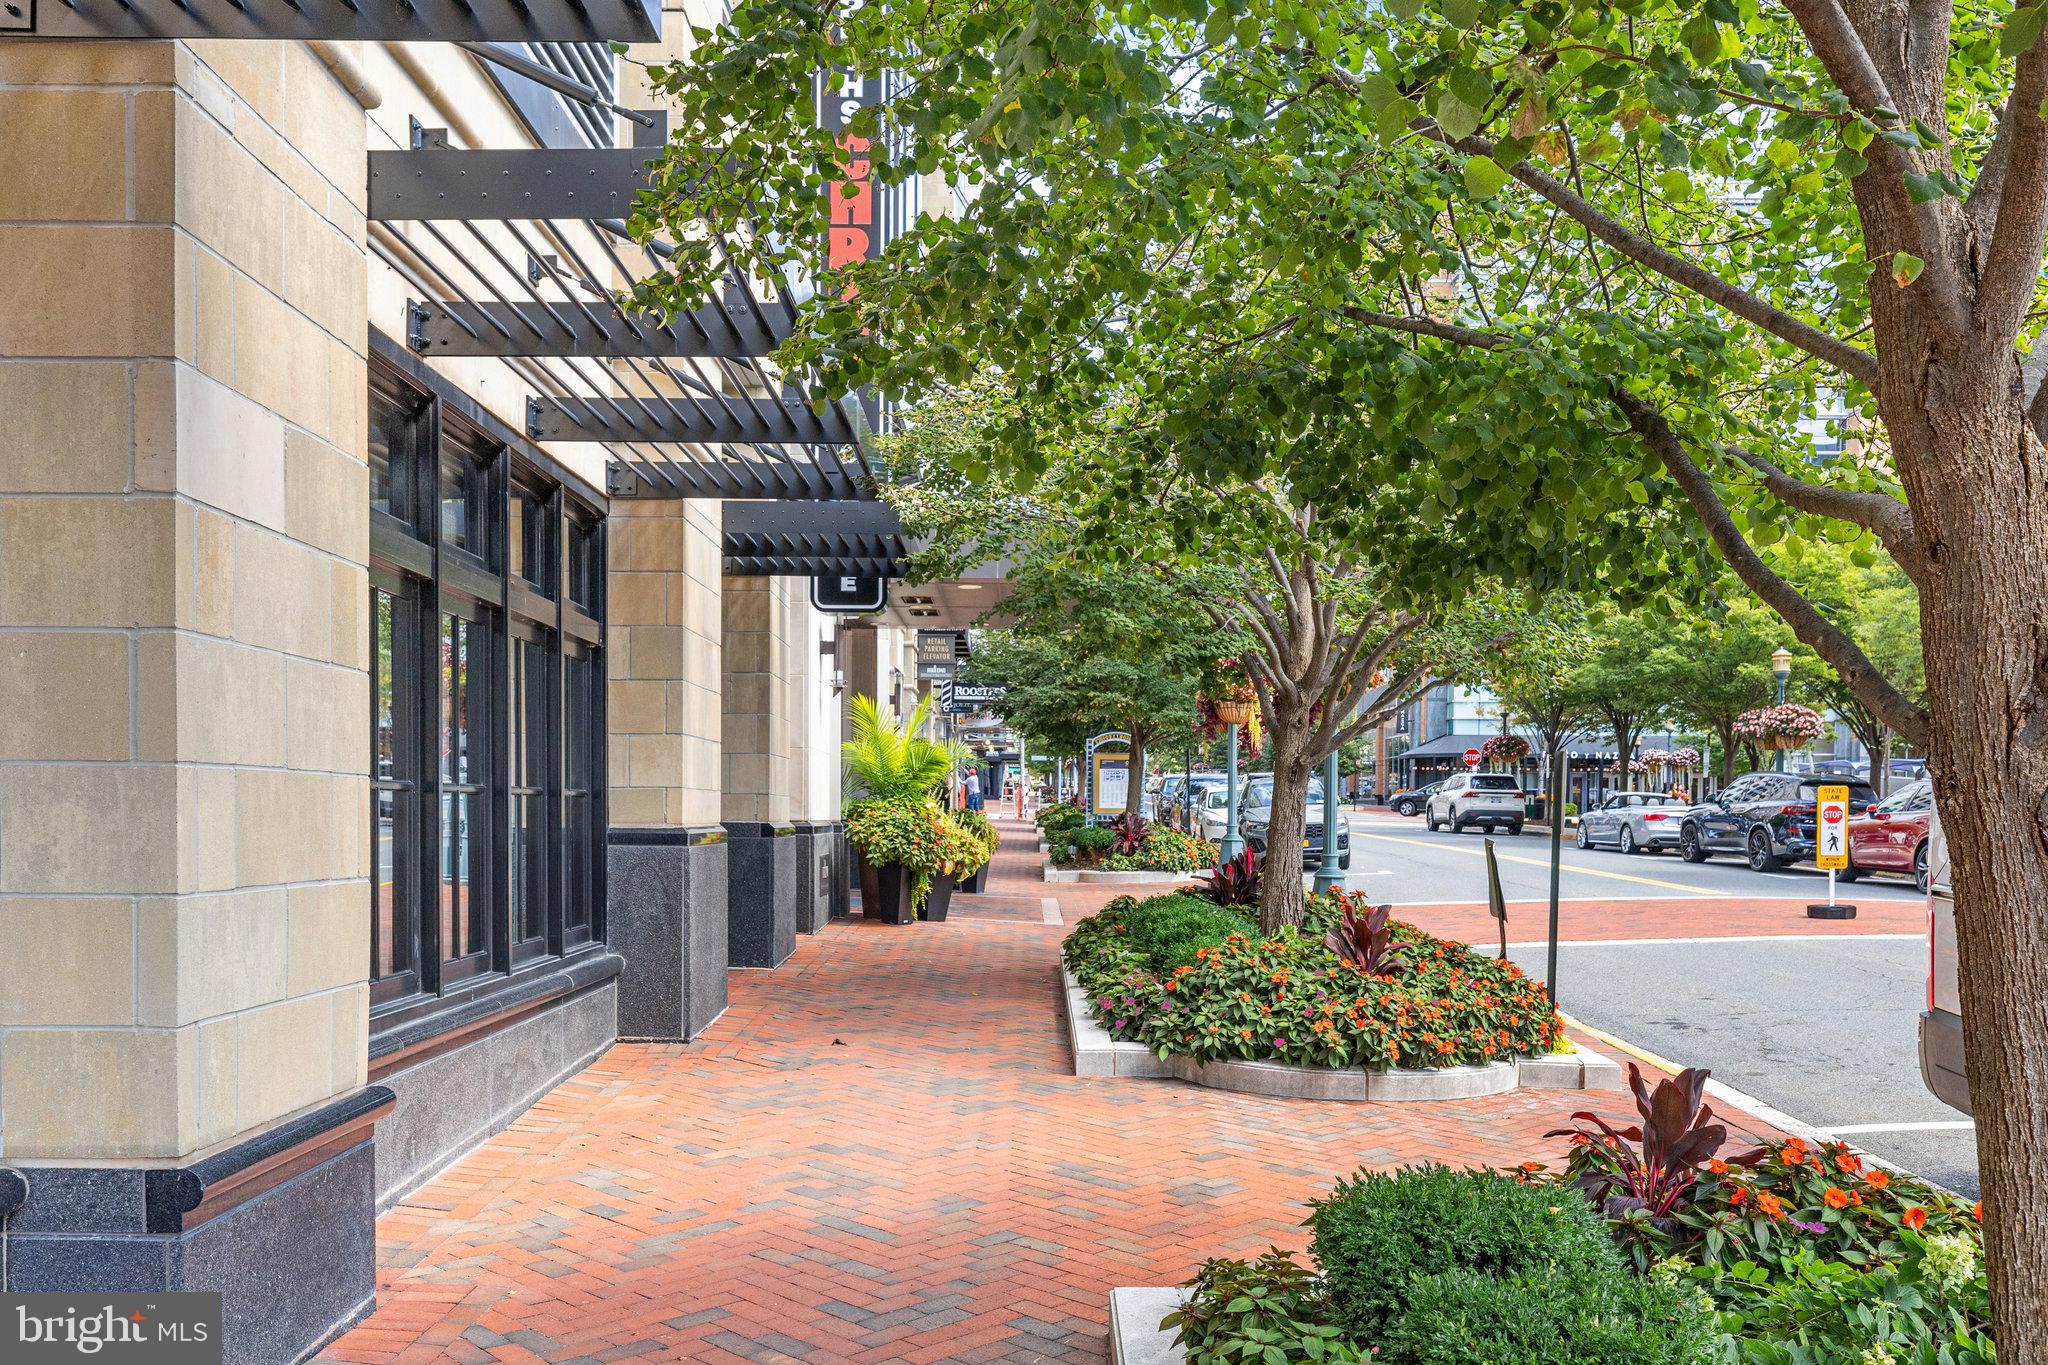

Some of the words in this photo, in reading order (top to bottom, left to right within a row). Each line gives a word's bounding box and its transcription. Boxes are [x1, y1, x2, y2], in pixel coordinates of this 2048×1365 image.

[927, 637, 946, 645] RETAIL
[1464, 753, 1480, 761] STOP
[1595, 751, 1636, 760] NAZA
[1824, 811, 1843, 819] STOP
